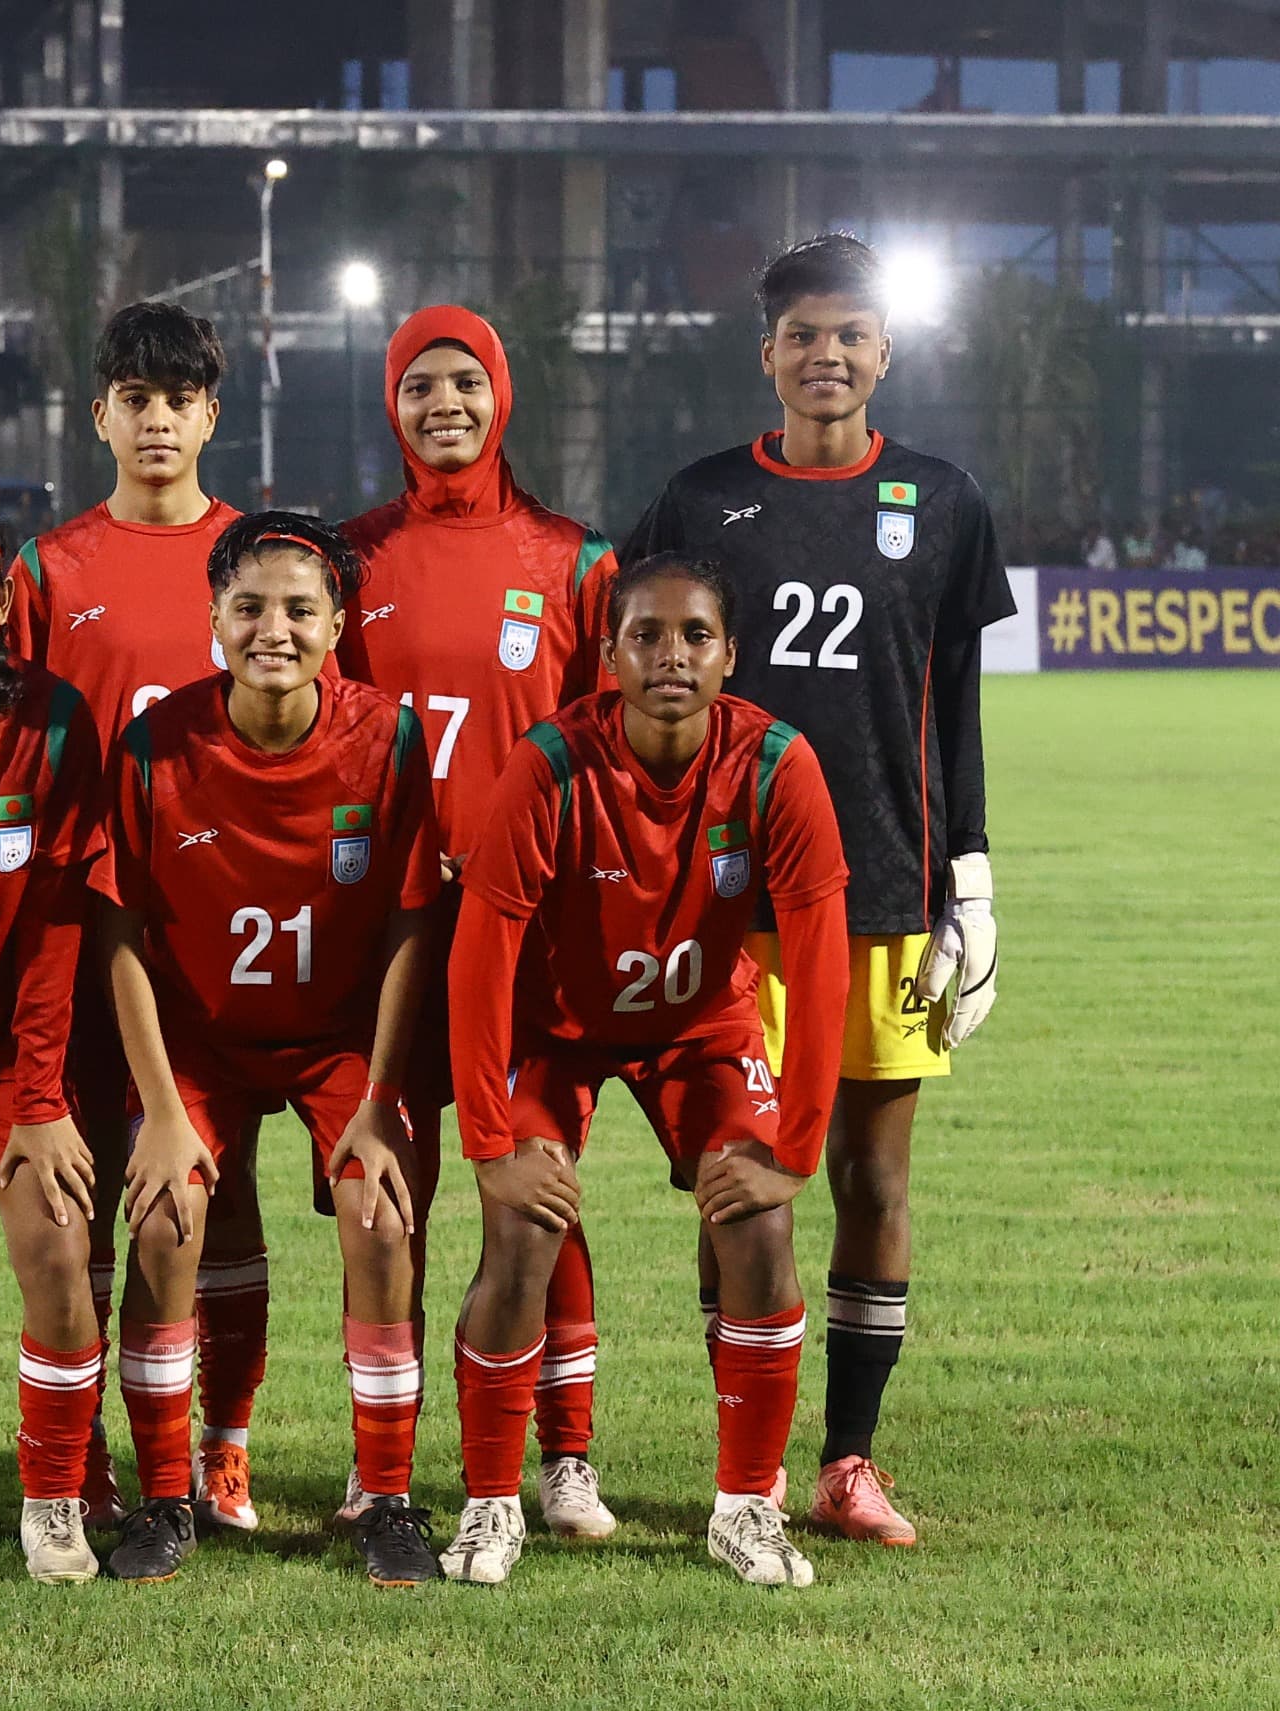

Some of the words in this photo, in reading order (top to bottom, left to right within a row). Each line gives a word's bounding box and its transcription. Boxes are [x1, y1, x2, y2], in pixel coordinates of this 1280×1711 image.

[770, 581, 864, 669] 22
[1047, 588, 1280, 654] #RESPEC
[400, 692, 470, 779] 7
[230, 905, 312, 984] 21
[613, 938, 703, 1013] 20
[741, 1056, 773, 1094] 20
[711, 1527, 756, 1574] GENESIS
